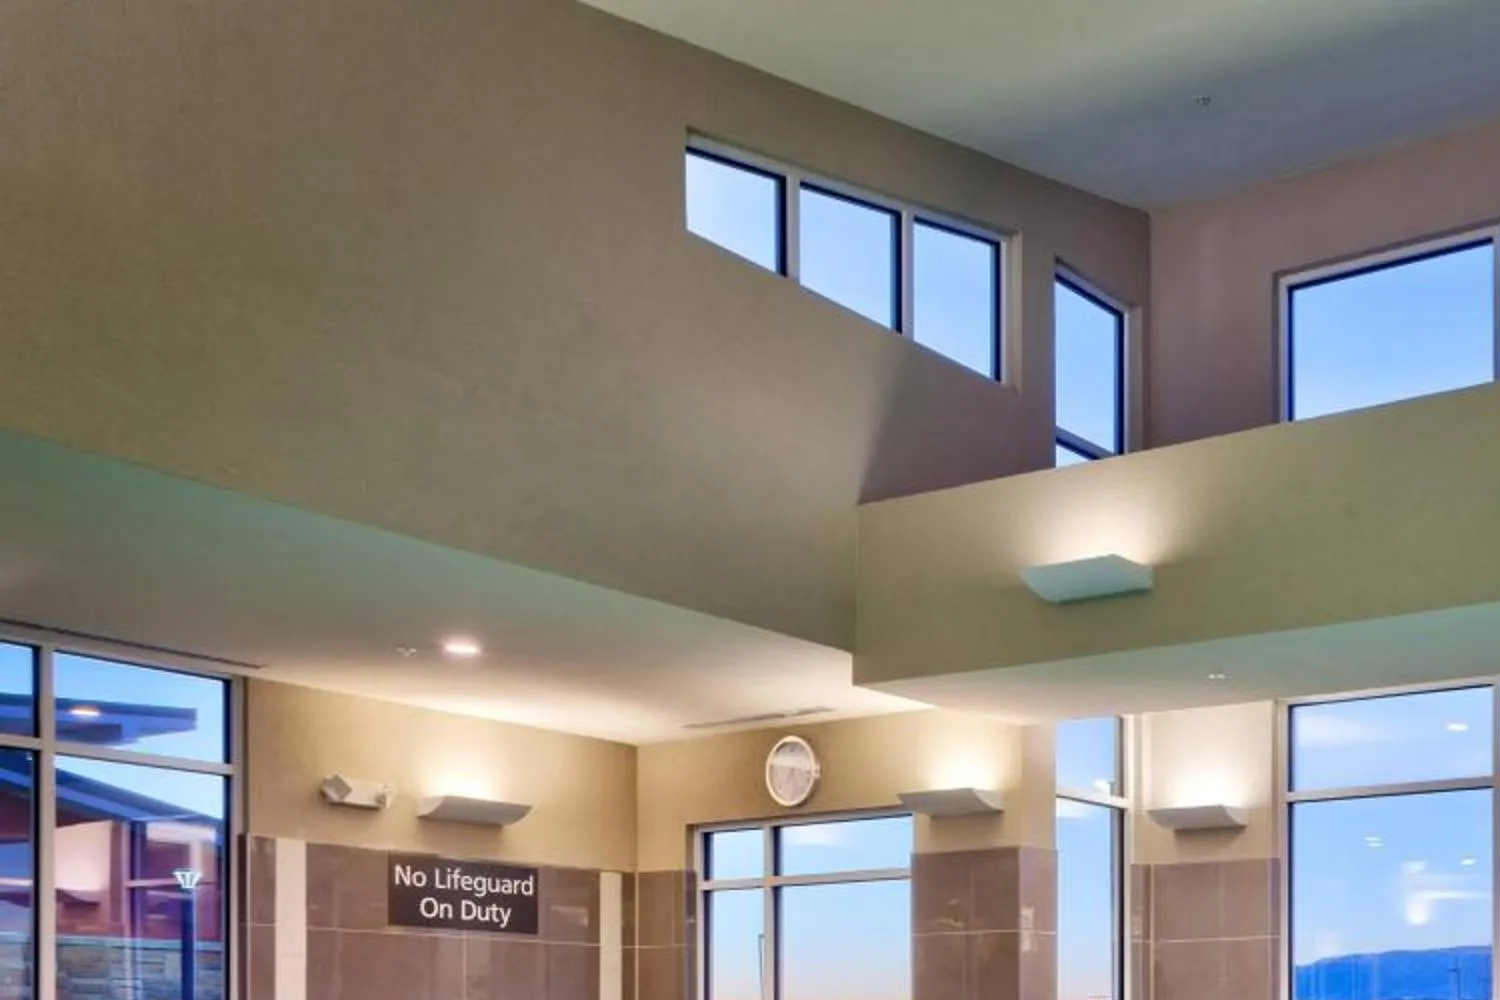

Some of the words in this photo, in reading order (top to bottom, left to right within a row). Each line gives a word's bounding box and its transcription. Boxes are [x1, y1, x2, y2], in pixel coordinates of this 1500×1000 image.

[394, 863, 427, 888] No
[434, 867, 535, 897] Lifeguard
[419, 897, 453, 919] On
[460, 900, 512, 928] Duty
